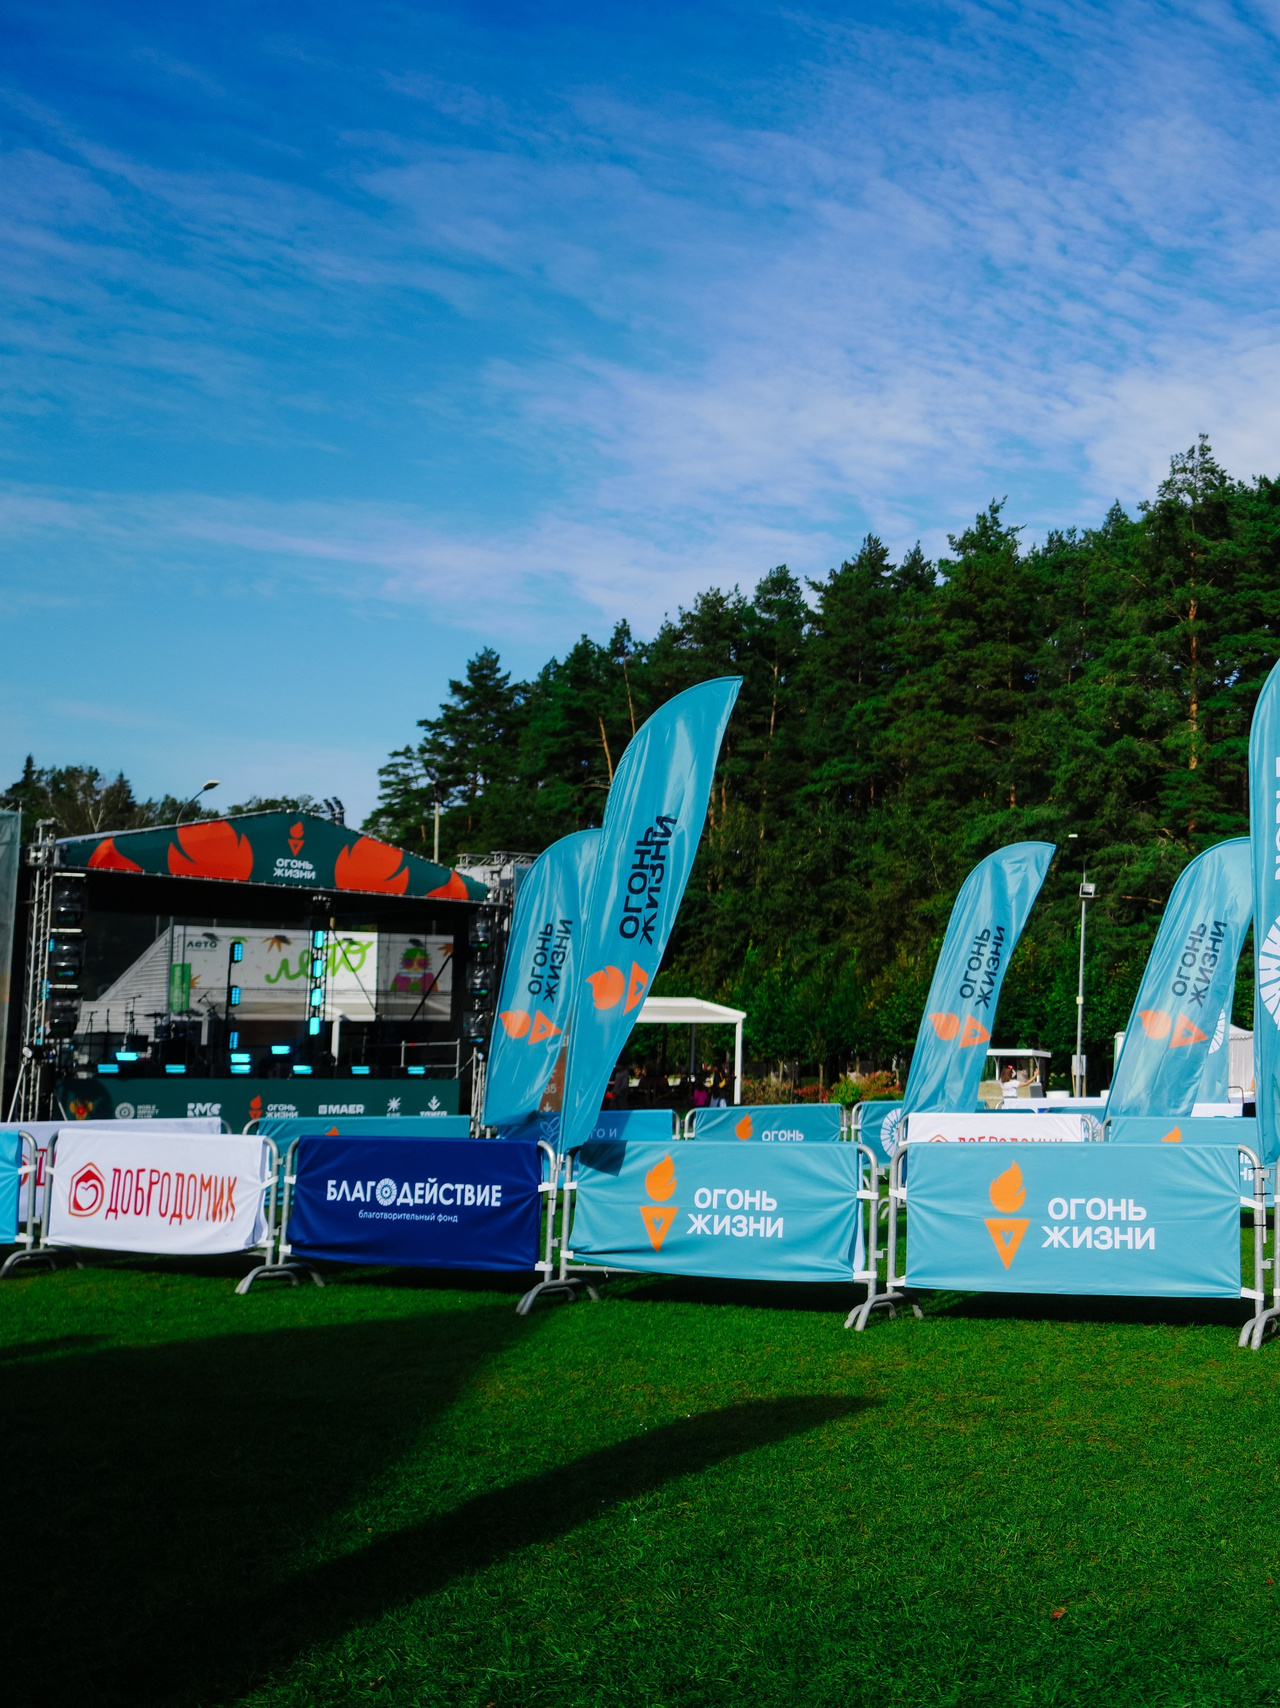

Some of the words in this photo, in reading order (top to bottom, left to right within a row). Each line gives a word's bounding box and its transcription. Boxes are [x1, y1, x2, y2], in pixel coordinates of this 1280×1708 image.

[273, 867, 317, 880] ЖИЗНИ
[275, 857, 314, 870] ОГОНЬ
[619, 826, 654, 940] ОГОНЬ
[639, 815, 677, 946] ЖИЗНИ
[528, 922, 554, 996] ОГОНЬ
[543, 919, 573, 1003] ЖИЗНИ
[959, 928, 991, 999] ОГОНЬ
[974, 925, 1005, 1010] ЖИЗНИ
[1171, 923, 1207, 997] ОГОНЬ
[1187, 920, 1227, 1008] ЖИЗНИ
[267, 1103, 296, 1112] ОГОНЬ
[328, 1103, 365, 1115] MAER
[761, 1130, 804, 1141] ОГОНЬ
[105, 1167, 238, 1226] ДОБРОДОМИК
[693, 1187, 778, 1212] ОГОНЬ
[1047, 1197, 1147, 1221] ОГОНЬ
[358, 1209, 434, 1223] благотворительный
[436, 1211, 458, 1224] фонд
[687, 1213, 784, 1239] ЖИЗНИ
[1041, 1225, 1155, 1251] ЖИЗНИ
